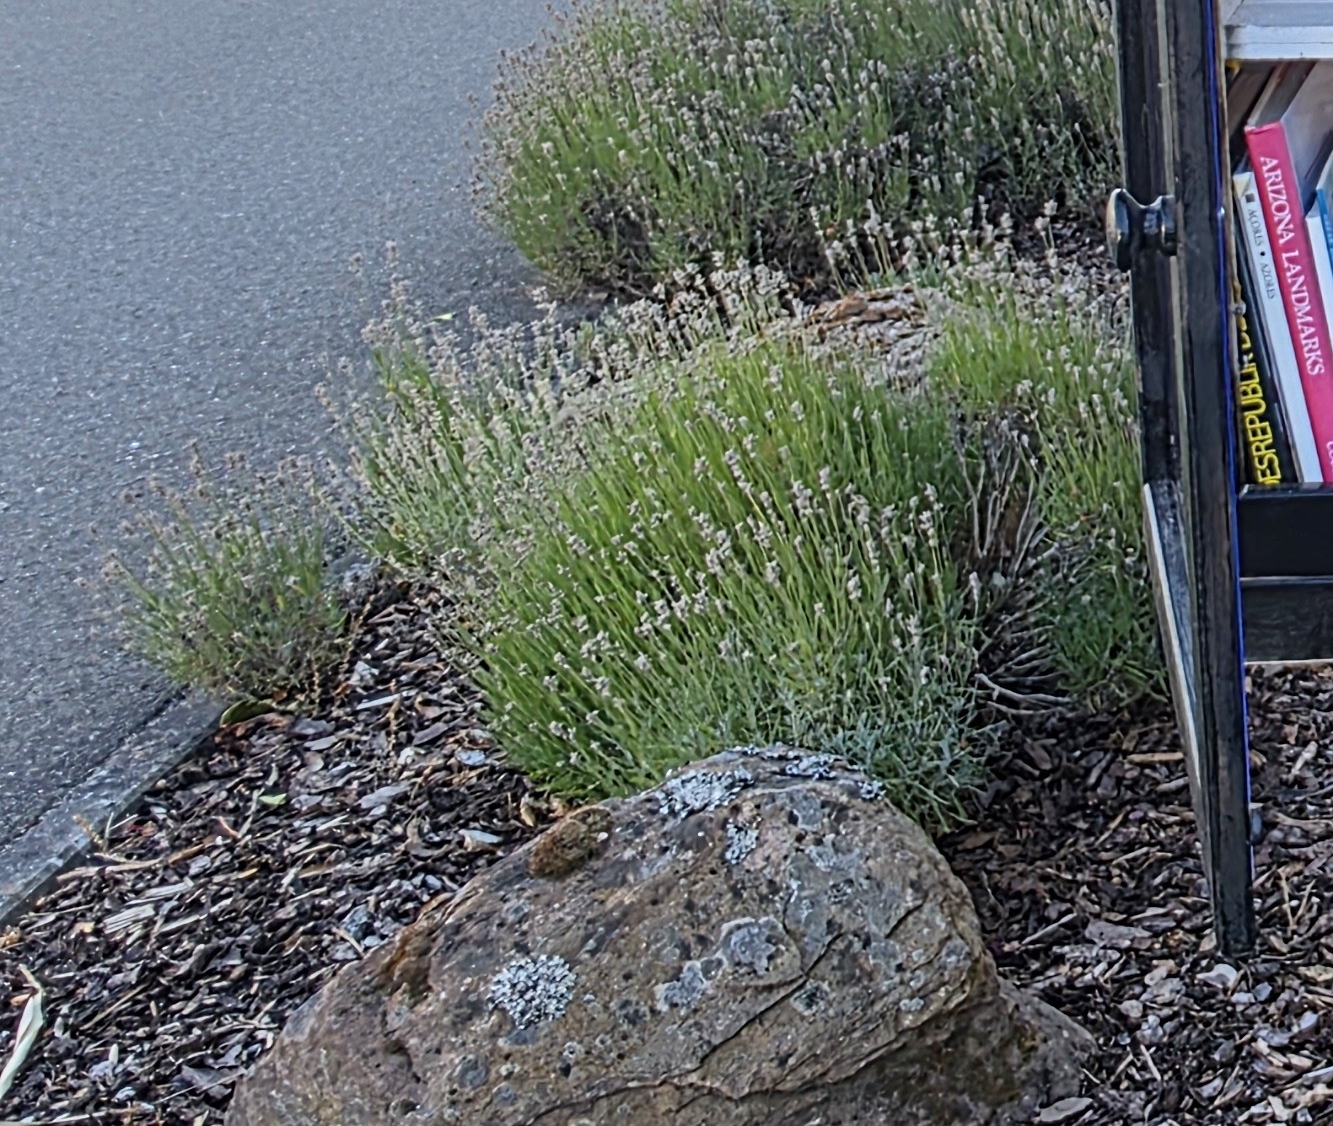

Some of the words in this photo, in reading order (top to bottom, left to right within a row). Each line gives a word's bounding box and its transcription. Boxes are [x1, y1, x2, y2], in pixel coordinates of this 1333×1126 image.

[1247, 208, 1265, 247] AÇORES
[1259, 262, 1277, 300] AZORES
[1259, 155, 1296, 244] ARIZONA
[1280, 250, 1325, 376] LANDMARKS
